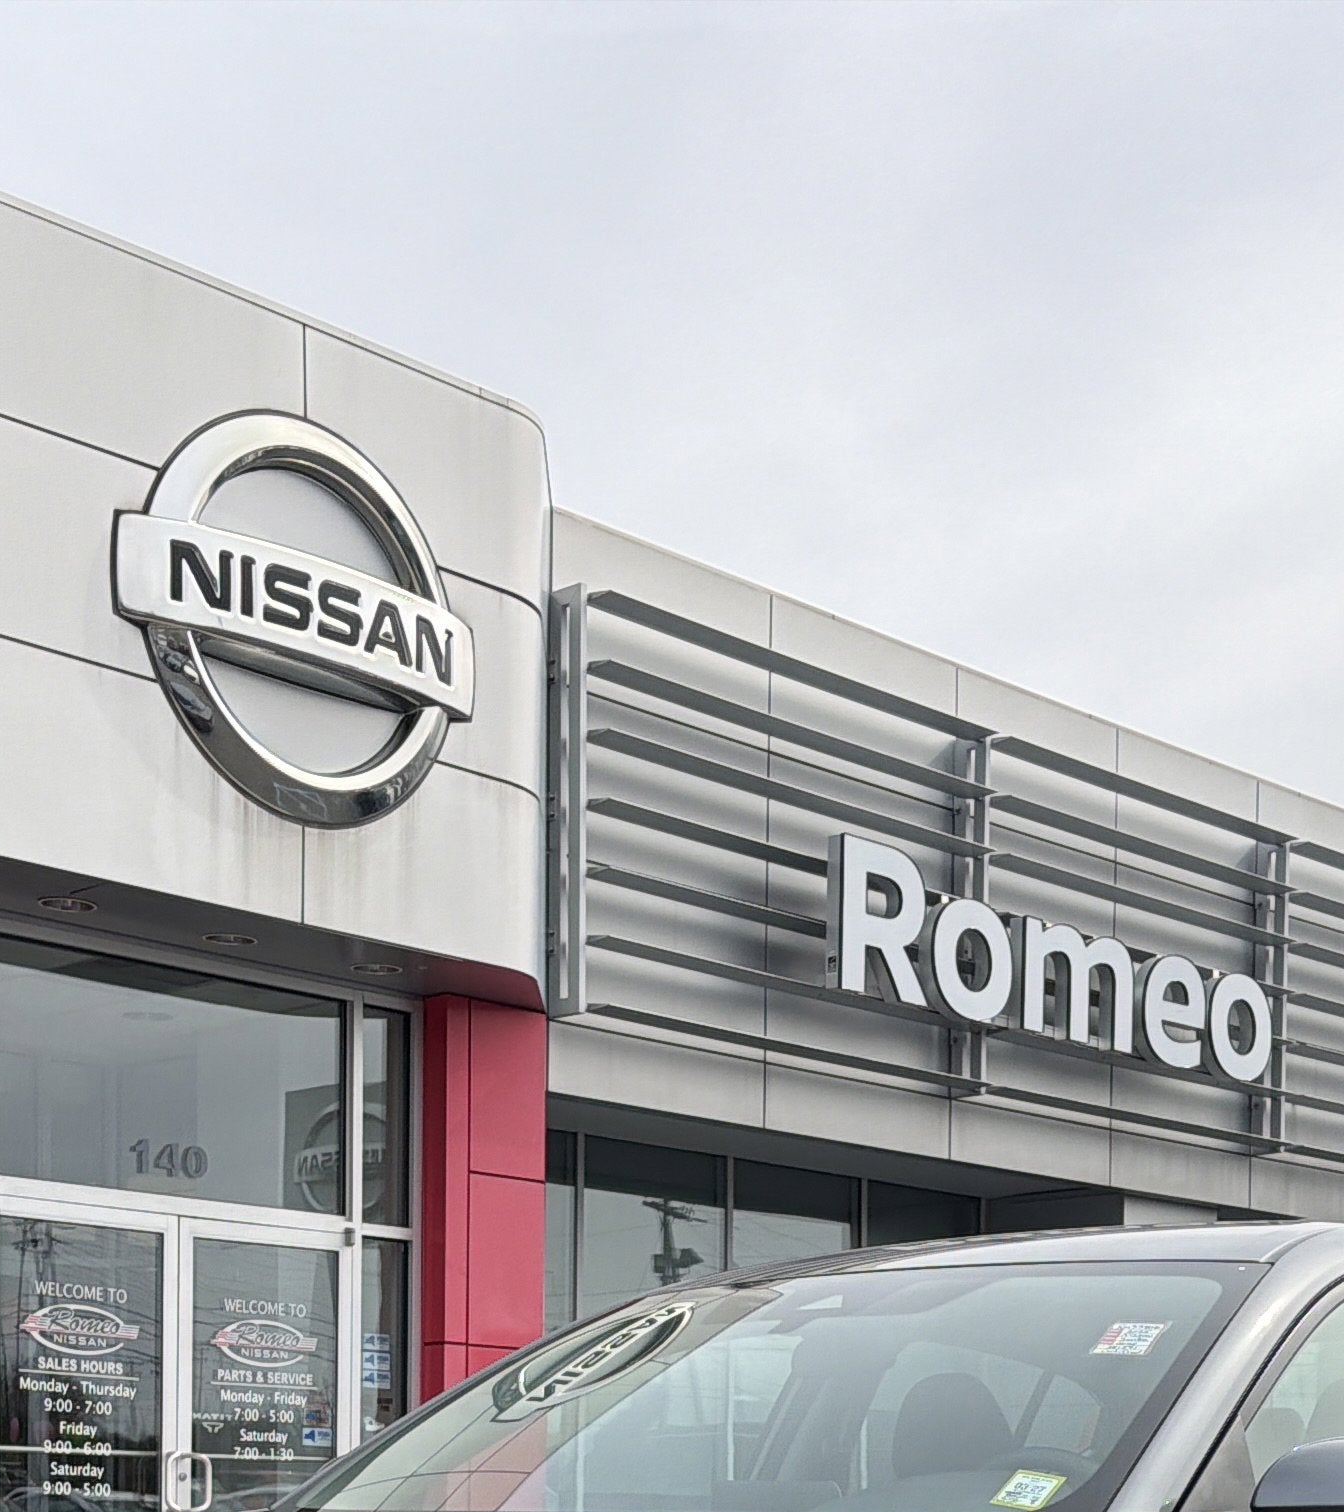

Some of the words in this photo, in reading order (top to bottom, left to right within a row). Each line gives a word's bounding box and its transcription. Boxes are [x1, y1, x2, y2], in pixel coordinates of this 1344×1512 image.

[169, 538, 455, 687] NISSAN
[830, 832, 1273, 1081] Romeo
[129, 1138, 208, 1179] 140
[35, 1280, 104, 1302] WELCOME
[107, 1288, 128, 1304] TO
[224, 1298, 286, 1317] WELCOME
[288, 1304, 307, 1318] TO
[43, 1307, 122, 1335] Romeo
[53, 1333, 107, 1348] NISSAN
[232, 1323, 302, 1348] Romeo
[240, 1347, 289, 1360] NISSAN
[37, 1356, 78, 1372] SALES
[80, 1361, 124, 1375] HOURS
[217, 1368, 253, 1382] PARTS
[256, 1370, 264, 1383] &
[267, 1372, 313, 1386] SERVICE
[19, 1376, 70, 1395] Monday
[80, 1381, 137, 1399] Thursday
[44, 1397, 73, 1413] 9:00
[84, 1400, 113, 1415] 7:00
[220, 1388, 265, 1406] Monday
[274, 1391, 308, 1408] Friday
[233, 1408, 259, 1422] 7:00
[269, 1410, 294, 1424] 5:00
[59, 1421, 98, 1439] Friday
[239, 1428, 289, 1445] Saturday
[43, 1439, 72, 1454] 9:00
[83, 1442, 112, 1456] 6:00
[233, 1446, 259, 1461] 7:00
[269, 1448, 294, 1461] 1:30
[50, 1461, 105, 1479] Saturday
[43, 1481, 72, 1495] 9:00
[83, 1482, 111, 1497] 5:00
